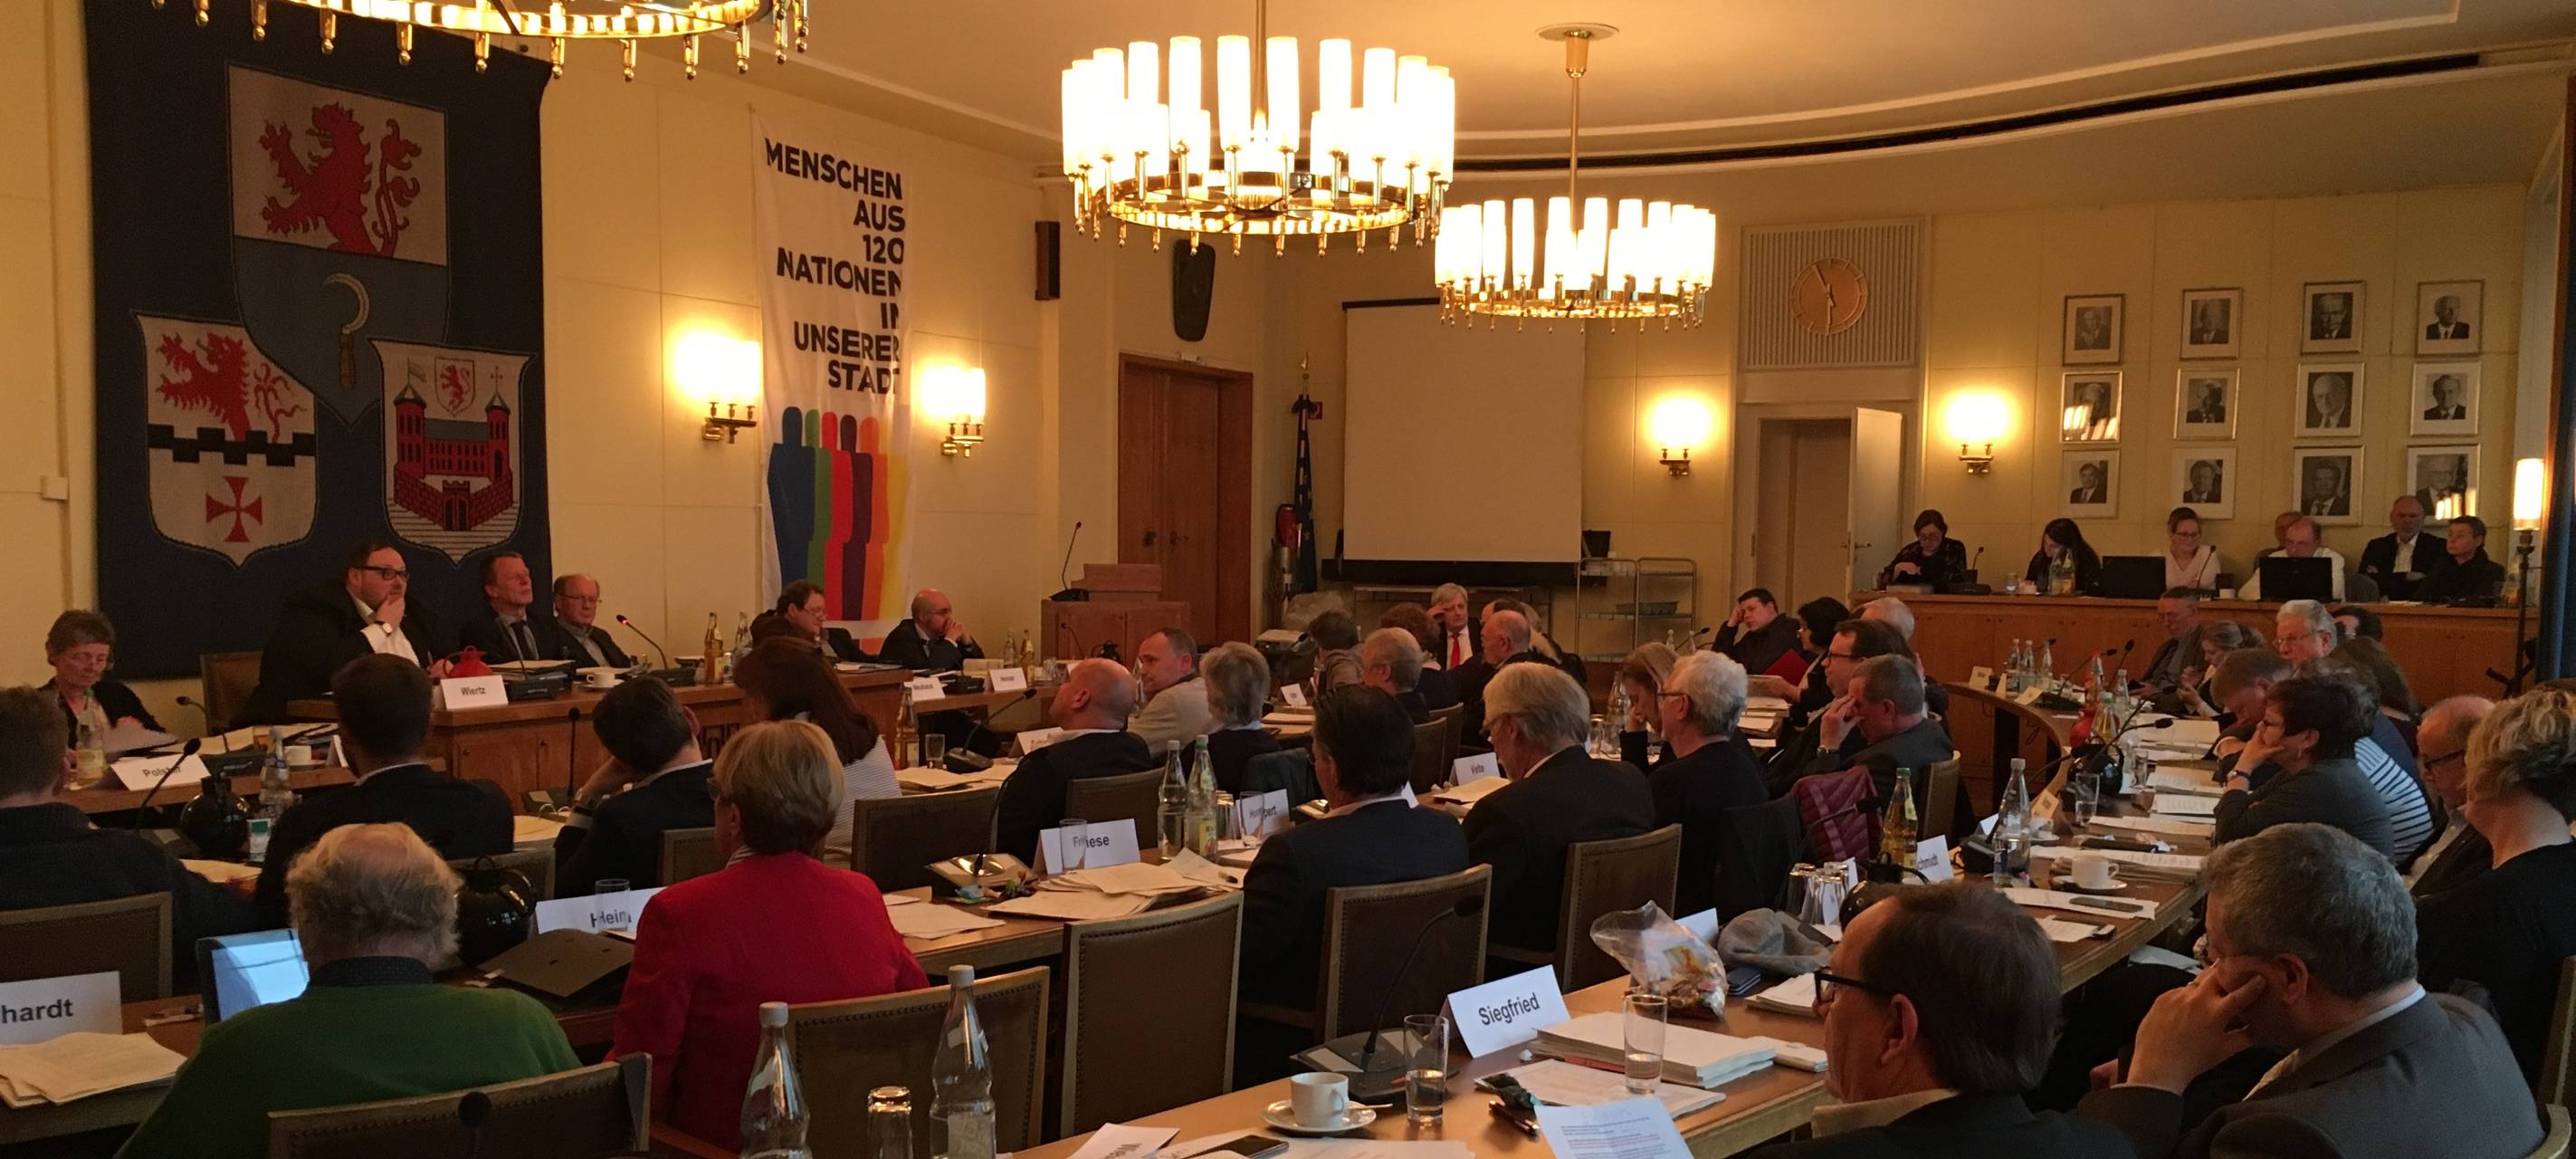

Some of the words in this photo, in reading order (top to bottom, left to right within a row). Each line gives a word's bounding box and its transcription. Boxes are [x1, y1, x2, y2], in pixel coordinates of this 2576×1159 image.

[764, 137, 903, 200] MENSCHEN
[853, 198, 906, 233] AUS
[863, 234, 905, 264] 120
[776, 246, 902, 297] NATIONEN
[793, 321, 901, 362] UNSERER
[827, 359, 901, 396] STADT
[460, 686, 486, 696] Wiertz
[1, 999, 74, 1024] hardt
[1478, 991, 1541, 1026] Siegfried
